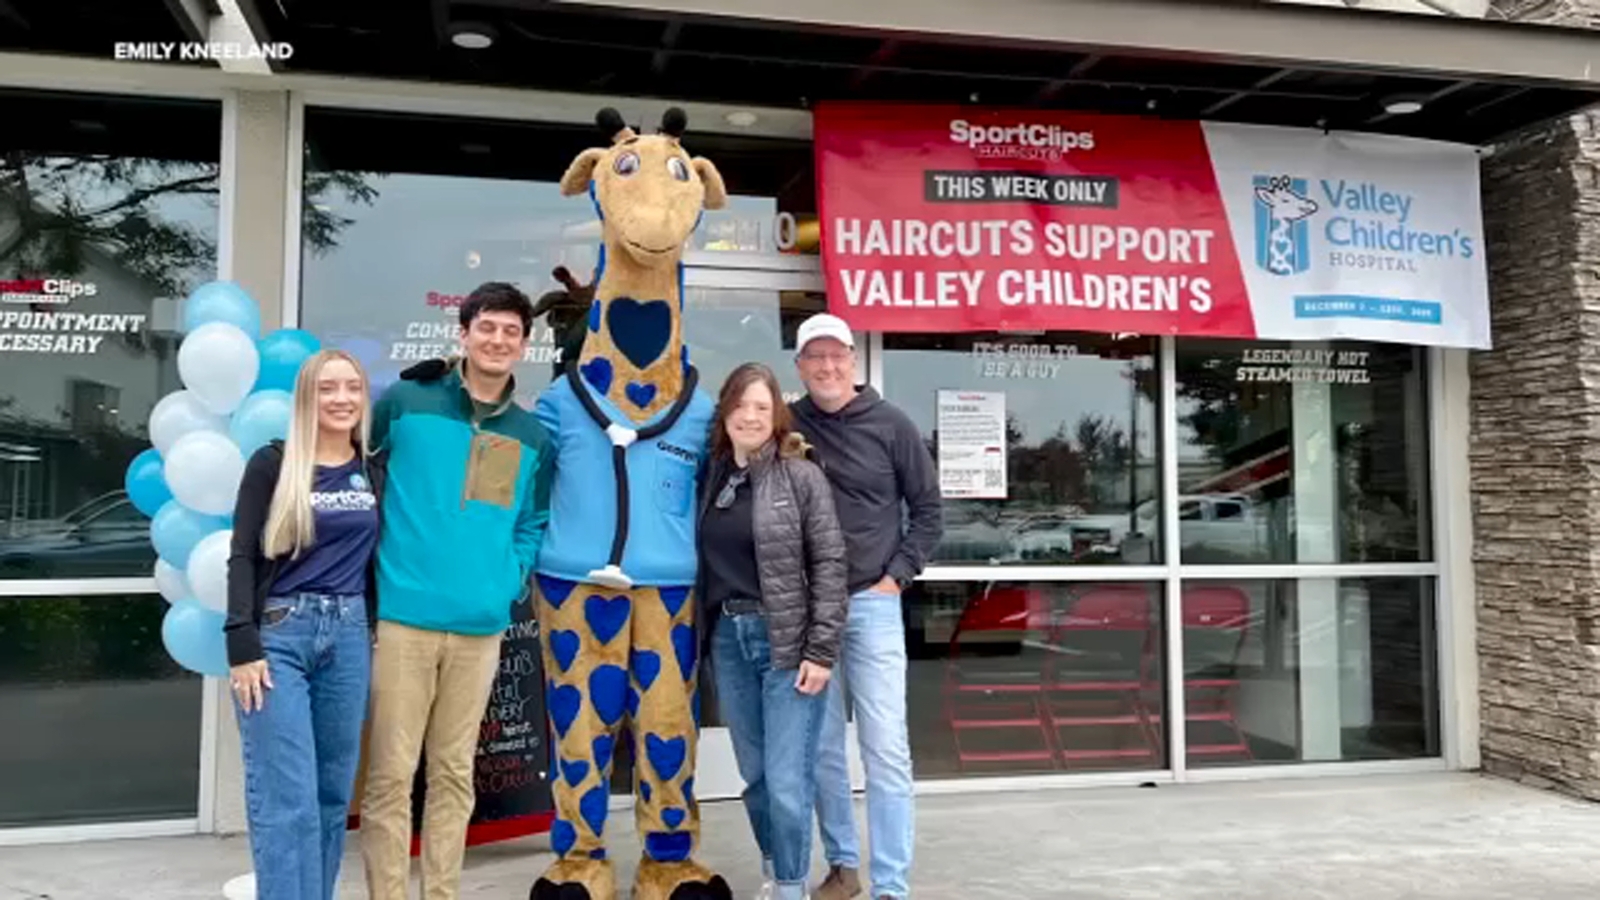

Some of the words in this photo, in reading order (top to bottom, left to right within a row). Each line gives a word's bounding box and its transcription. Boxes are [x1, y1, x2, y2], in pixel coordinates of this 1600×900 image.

[949, 119, 1095, 153] SportClips
[934, 176, 985, 198] THIS
[991, 177, 1048, 199] WEEK
[1054, 180, 1107, 203] ONLY
[1320, 179, 1413, 223] Valley
[835, 218, 1034, 257] HAIRCUTS
[1045, 223, 1215, 263] SUPPORT
[1325, 217, 1474, 258] Children's
[1329, 252, 1418, 273] HOSPITAL
[840, 269, 985, 306] VALLEY
[998, 270, 1212, 312] CHILDREN'S
[0, 311, 145, 332] POINTMENT
[1242, 349, 1335, 365] LEGENDARY
